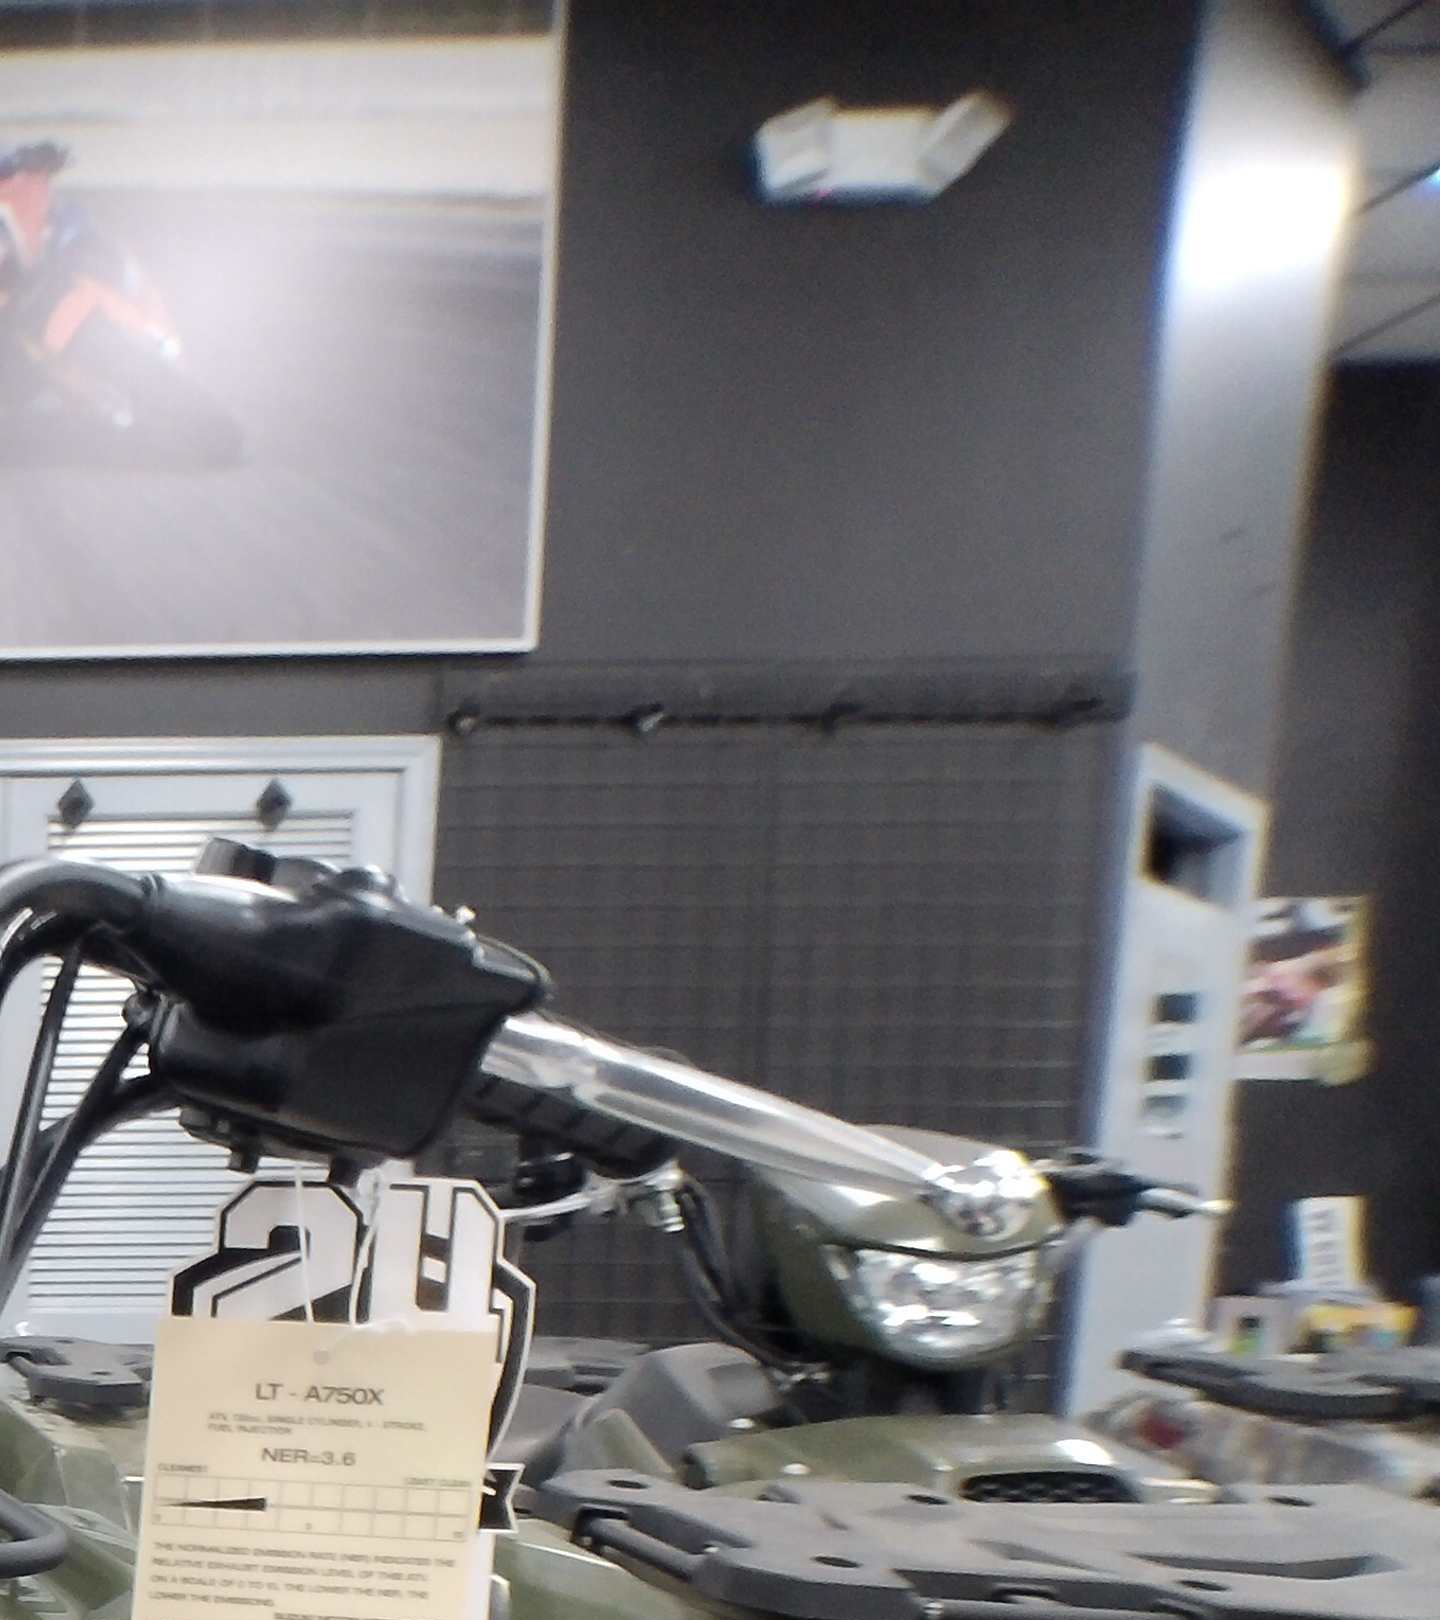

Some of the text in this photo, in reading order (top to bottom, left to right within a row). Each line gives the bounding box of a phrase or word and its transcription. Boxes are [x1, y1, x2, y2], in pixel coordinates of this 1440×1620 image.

[255, 1382, 284, 1401] LT
[304, 1386, 385, 1406] A750X
[261, 1447, 356, 1467] NER=3.6
